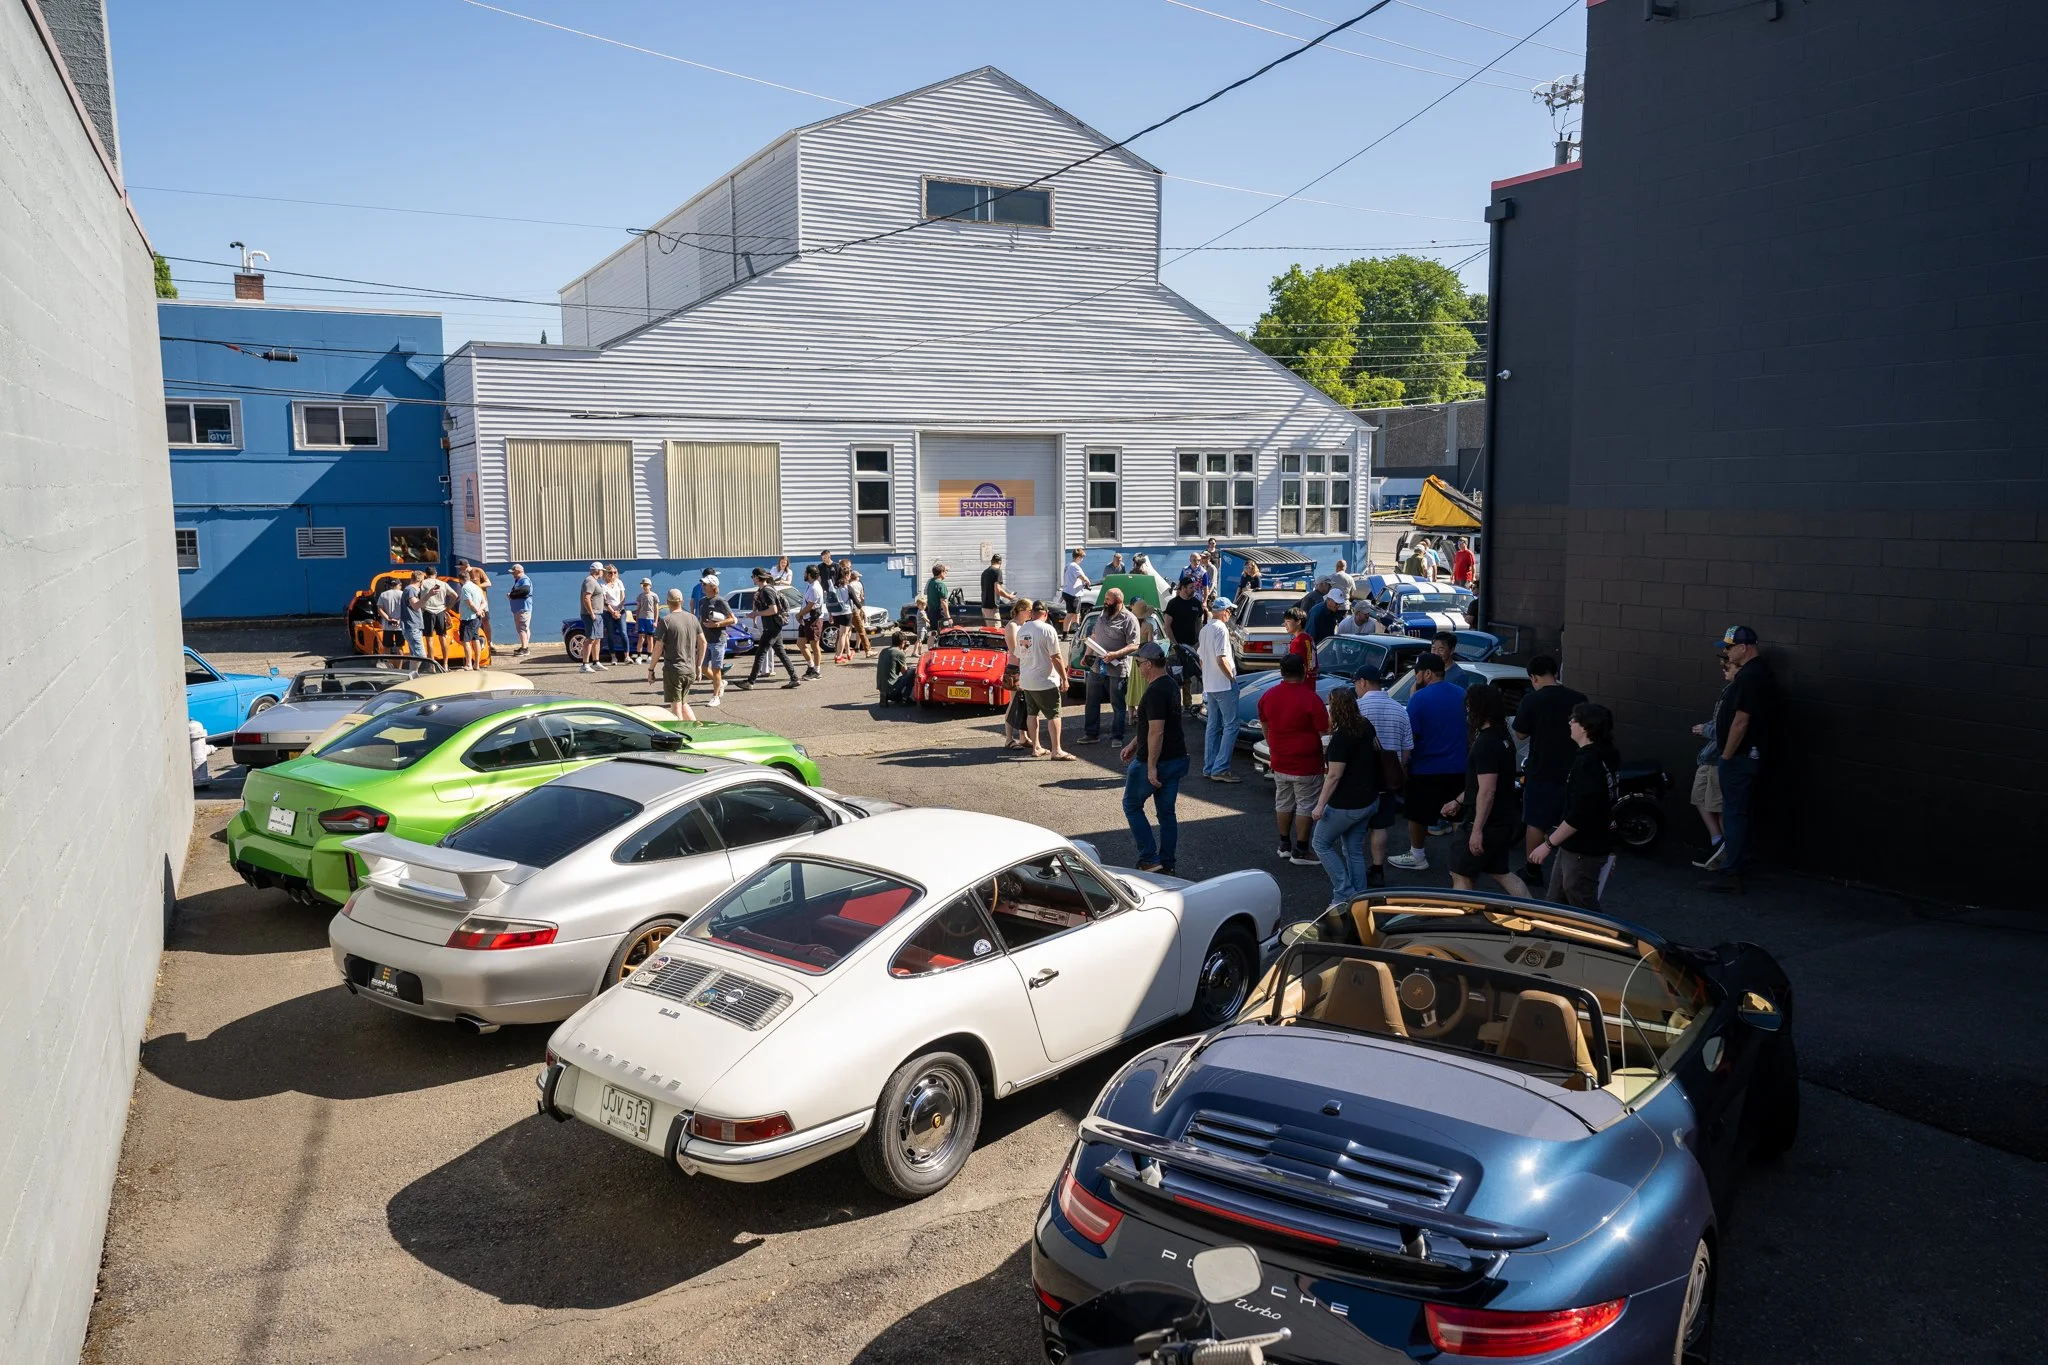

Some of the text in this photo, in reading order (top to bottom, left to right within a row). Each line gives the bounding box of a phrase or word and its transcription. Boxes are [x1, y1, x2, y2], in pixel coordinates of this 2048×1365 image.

[962, 501, 1013, 509] SUNSHINE
[577, 1042, 682, 1091] PORSCHE
[603, 1090, 624, 1116] JJV
[1161, 1249, 1350, 1316] PCHE
